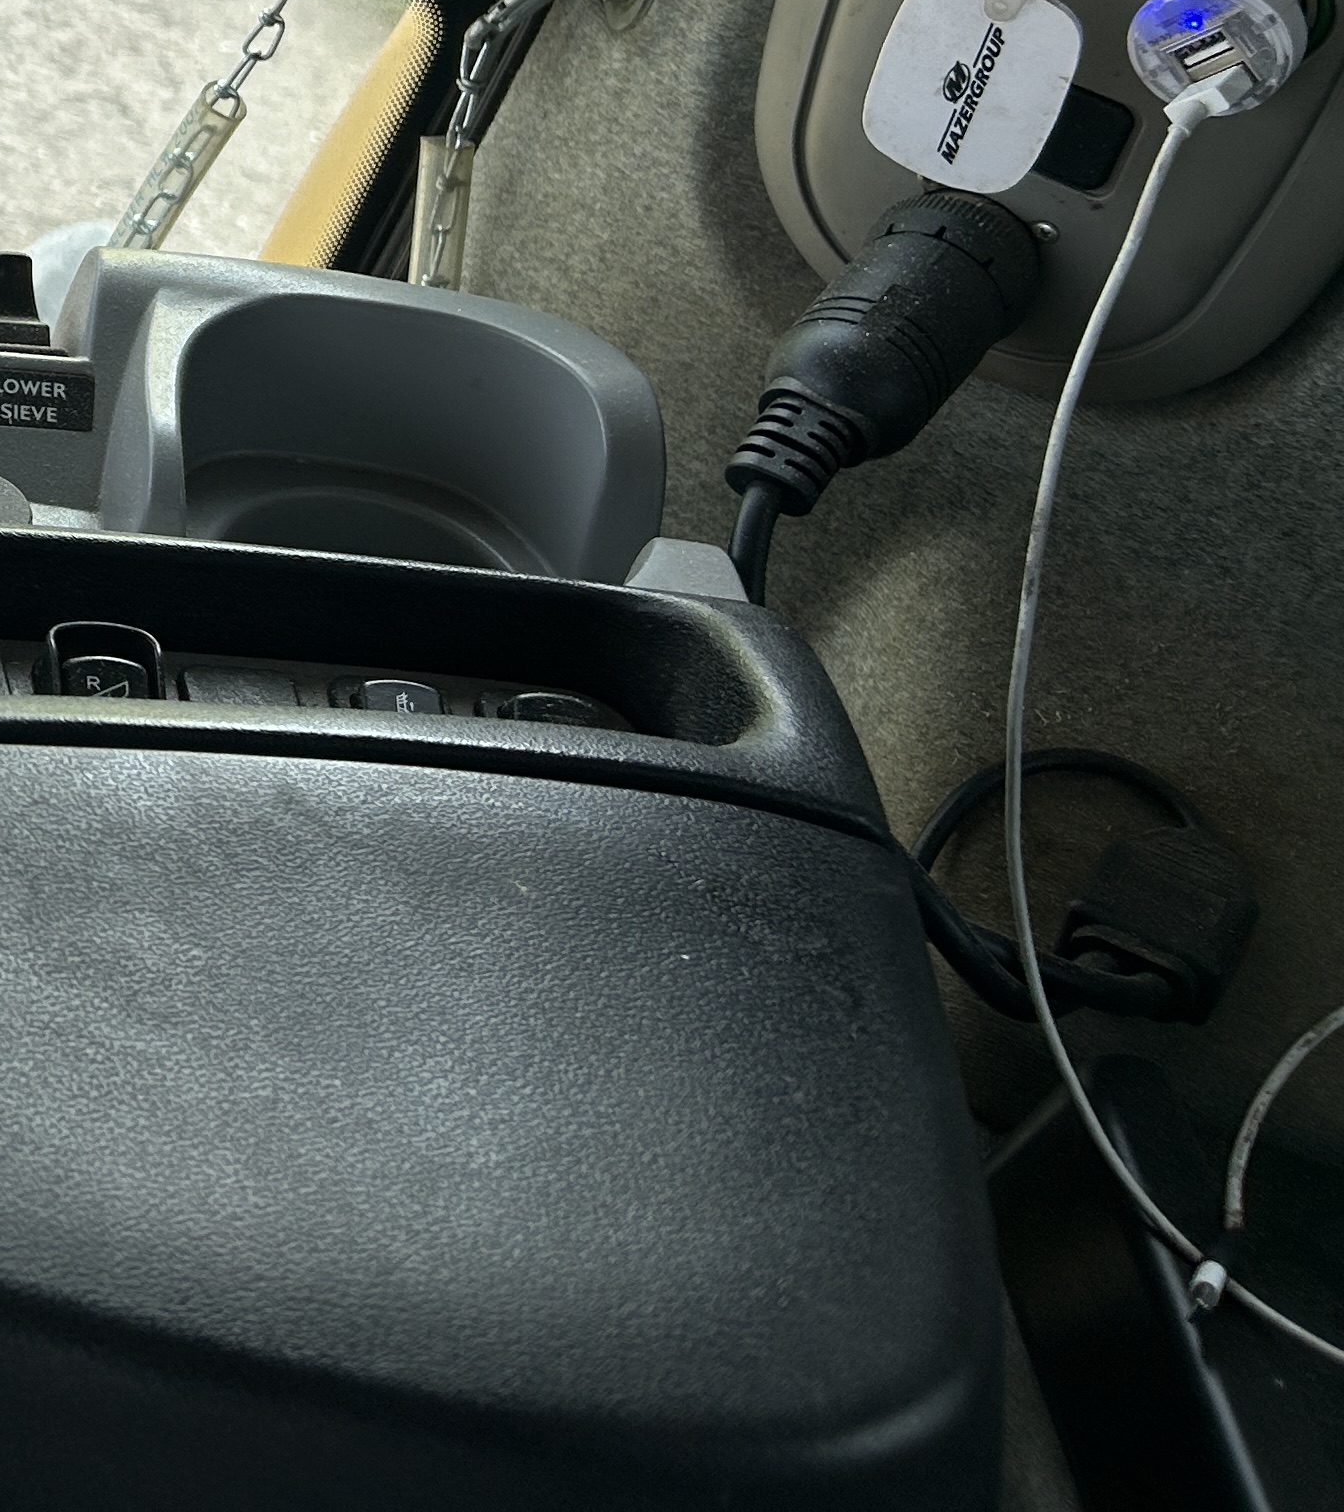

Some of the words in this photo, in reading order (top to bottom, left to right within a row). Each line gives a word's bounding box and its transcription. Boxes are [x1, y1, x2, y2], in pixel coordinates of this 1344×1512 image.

[940, 27, 1005, 165] MAZERGROUP
[0, 402, 58, 423] SIEVE
[86, 675, 101, 691] R
